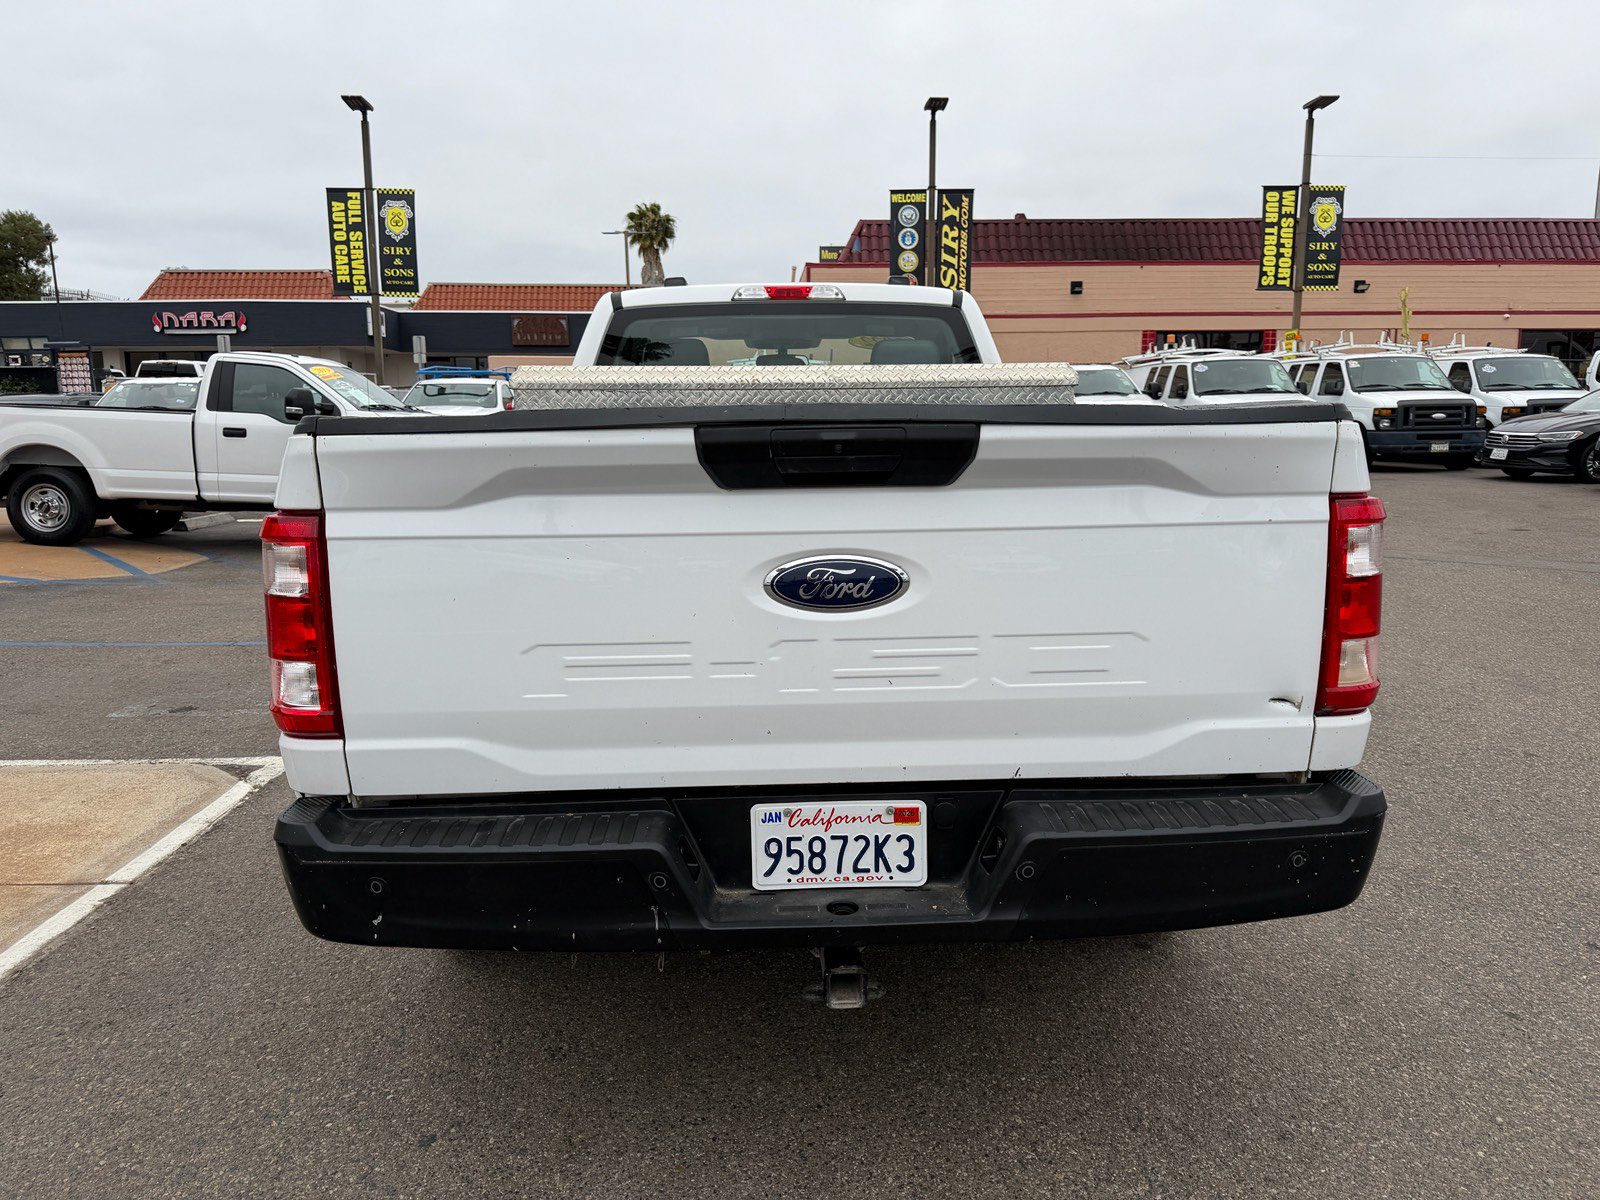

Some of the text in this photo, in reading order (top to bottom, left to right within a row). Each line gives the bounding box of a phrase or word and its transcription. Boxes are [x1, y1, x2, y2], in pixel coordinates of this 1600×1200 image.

[891, 193, 926, 203] WELCOME
[331, 201, 350, 283] AUTO CARE
[347, 192, 367, 293] FULL SERVICE
[383, 246, 412, 255] SIRY
[940, 194, 960, 291] SIRY
[958, 195, 970, 291] MOTORS.COM
[1261, 191, 1279, 286] OUR TROOPS
[1277, 190, 1296, 287] WE SUPPORT
[1308, 242, 1337, 250] SIRY
[821, 249, 838, 260] More
[1306, 263, 1337, 271] SONS
[384, 268, 414, 277] SONS
[799, 567, 876, 600] Ford
[761, 811, 782, 823] JAN
[787, 806, 895, 832] California
[763, 834, 915, 877] 95872K3
[796, 875, 884, 883] dmv.ca.gov
